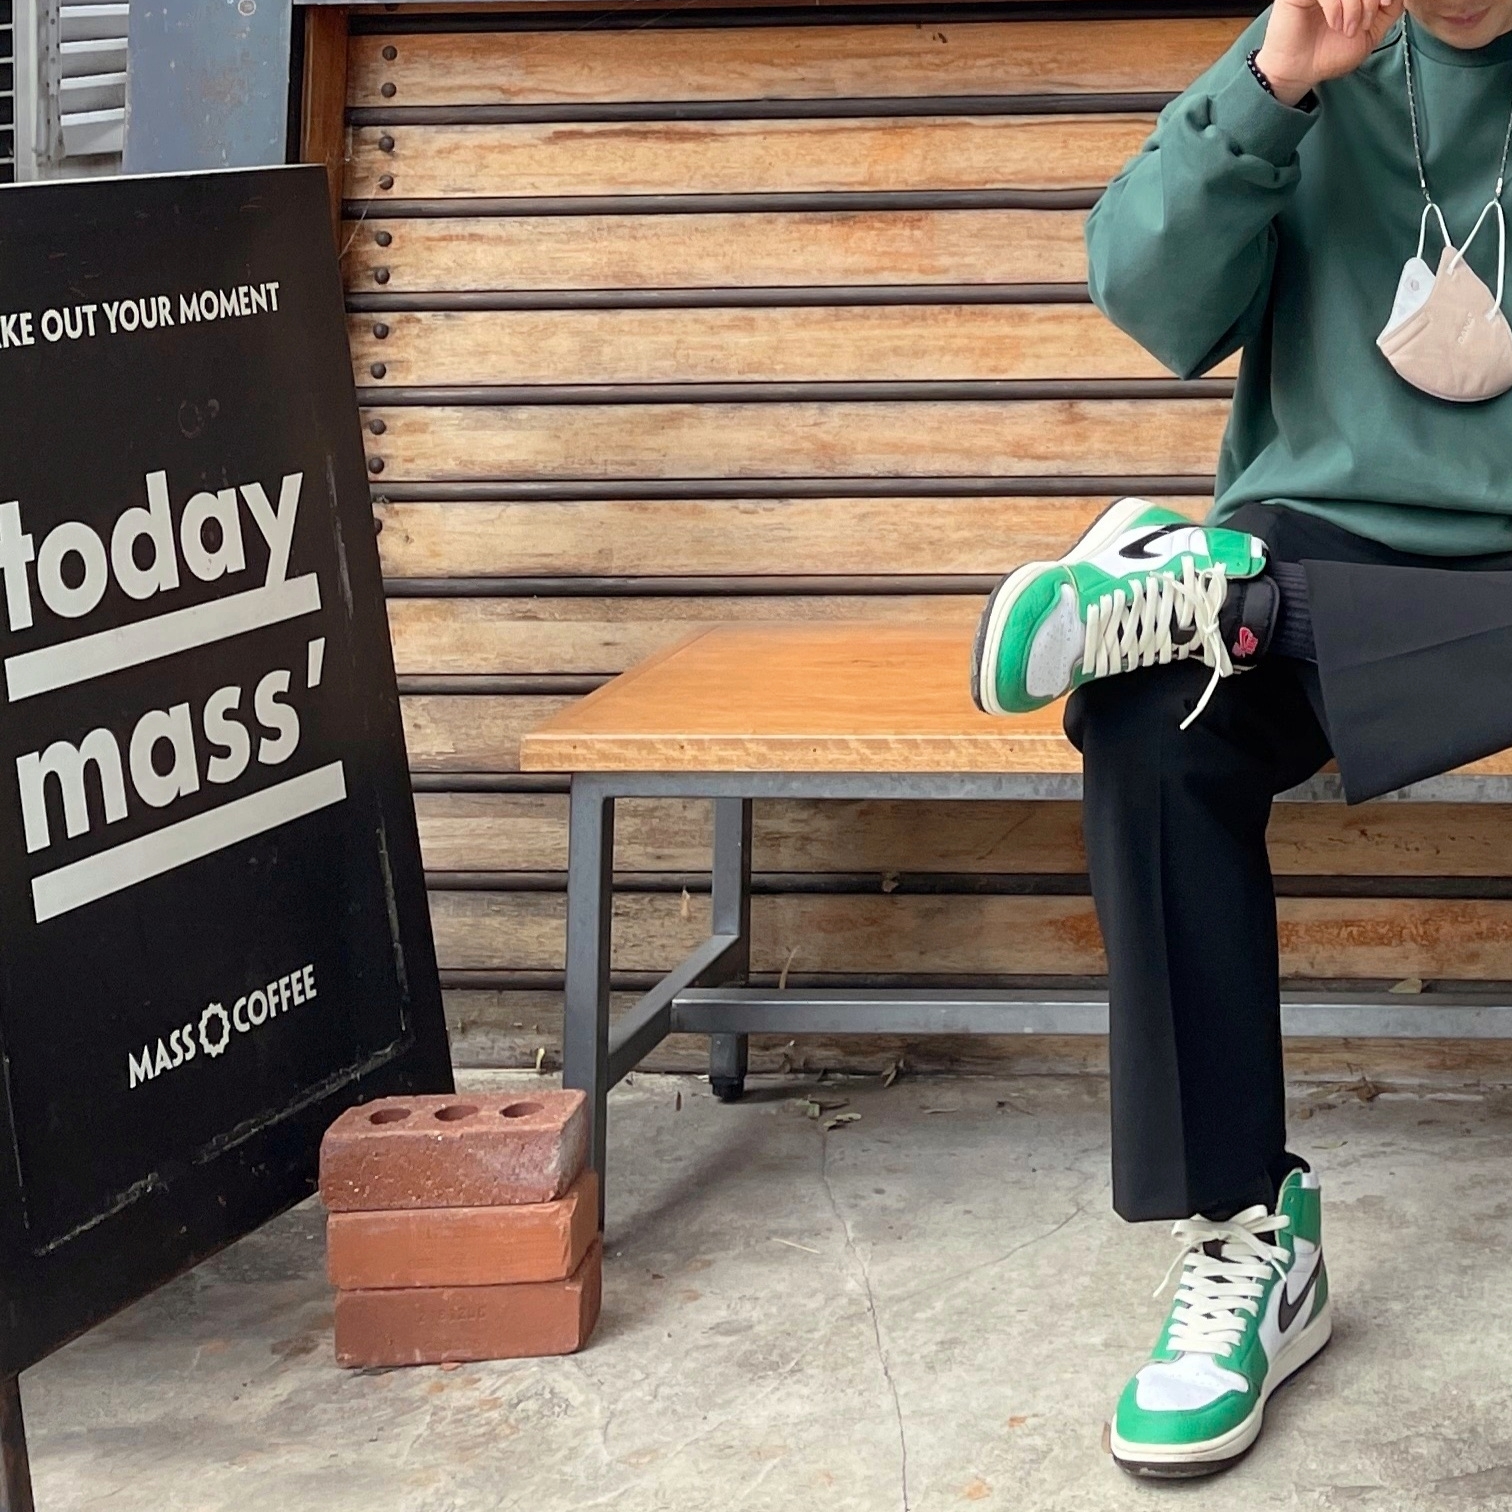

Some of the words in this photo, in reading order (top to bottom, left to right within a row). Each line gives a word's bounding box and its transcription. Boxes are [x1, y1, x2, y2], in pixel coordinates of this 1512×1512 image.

[0, 312, 35, 349] KE
[41, 304, 97, 342] OUT
[102, 295, 175, 334] YOUR
[179, 282, 280, 324] MOMENT
[0, 470, 304, 633] today
[15, 637, 326, 855] mass'
[127, 1019, 196, 1089] MASS
[232, 964, 317, 1034] COFFEE
